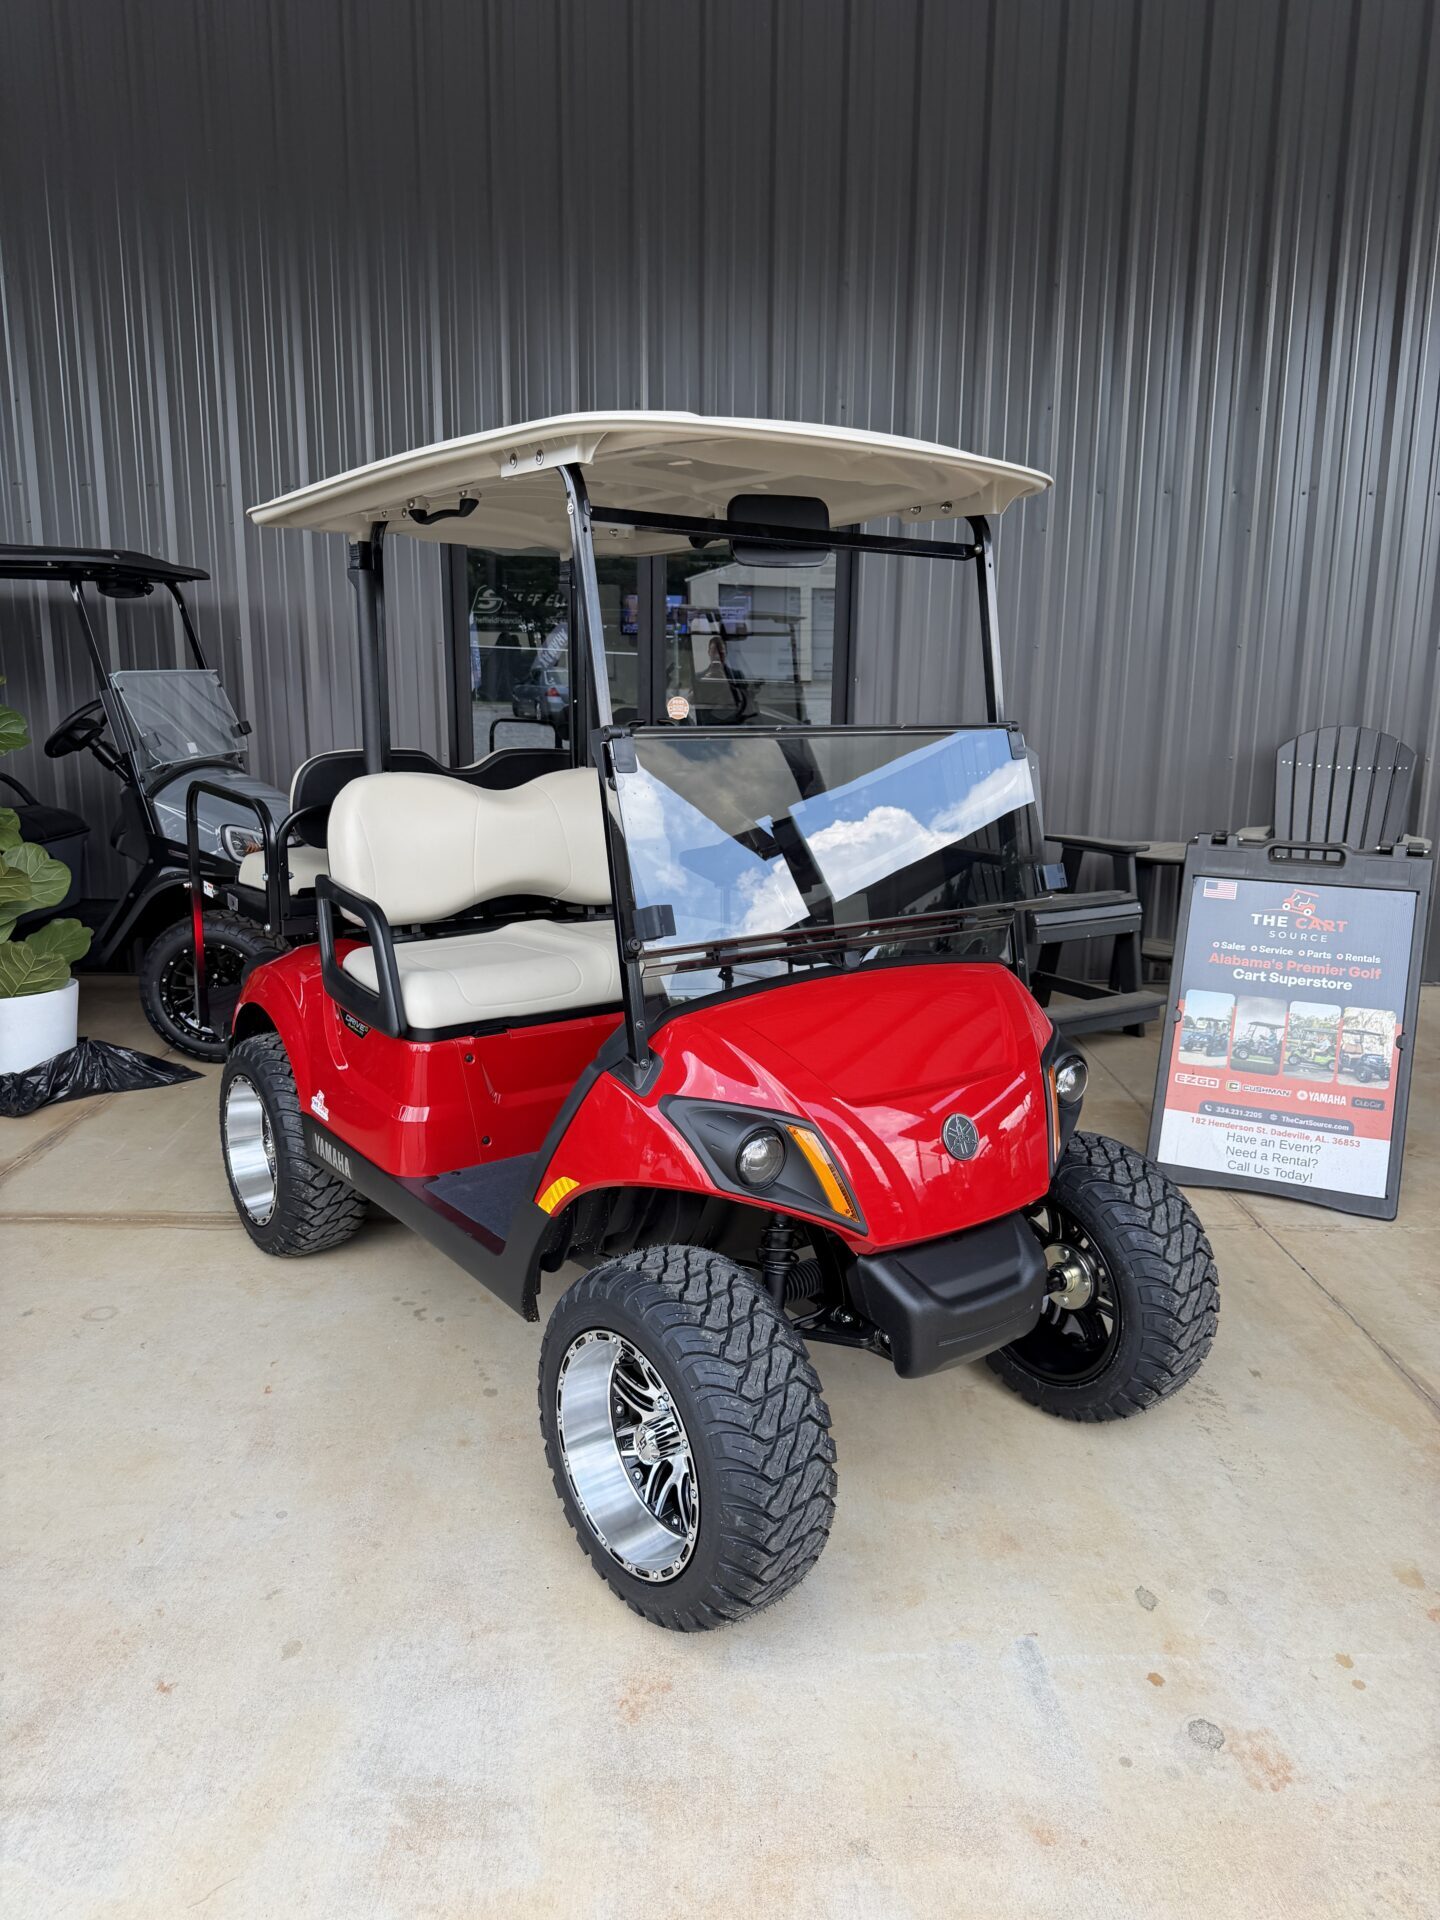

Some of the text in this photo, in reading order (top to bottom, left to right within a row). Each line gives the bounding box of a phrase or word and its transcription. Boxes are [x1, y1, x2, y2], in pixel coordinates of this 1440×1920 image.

[1251, 913, 1348, 932] THE CART
[1269, 931, 1328, 943] SOURCE
[1221, 941, 1381, 964] Sales Service Parts Rentals
[1209, 952, 1382, 980] Alabama's Premier Golf
[1233, 968, 1353, 991] Cart Superstore
[1243, 1084, 1291, 1097] CUSHMAN
[1309, 1091, 1347, 1106] YAMAHA
[1191, 1116, 1206, 1126] 182
[1208, 1118, 1254, 1133] Henderson
[1256, 1126, 1269, 1135] St.
[1270, 1128, 1313, 1143] Dadeville,
[1332, 1137, 1361, 1148] 36853
[1282, 1115, 1349, 1131] TheCartSource.com
[1227, 1132, 1322, 1155] Have an Event?
[315, 1132, 352, 1179] YAMAHA
[1226, 1145, 1319, 1169] Need a Rental?
[1227, 1160, 1314, 1184] Call Us Today!
